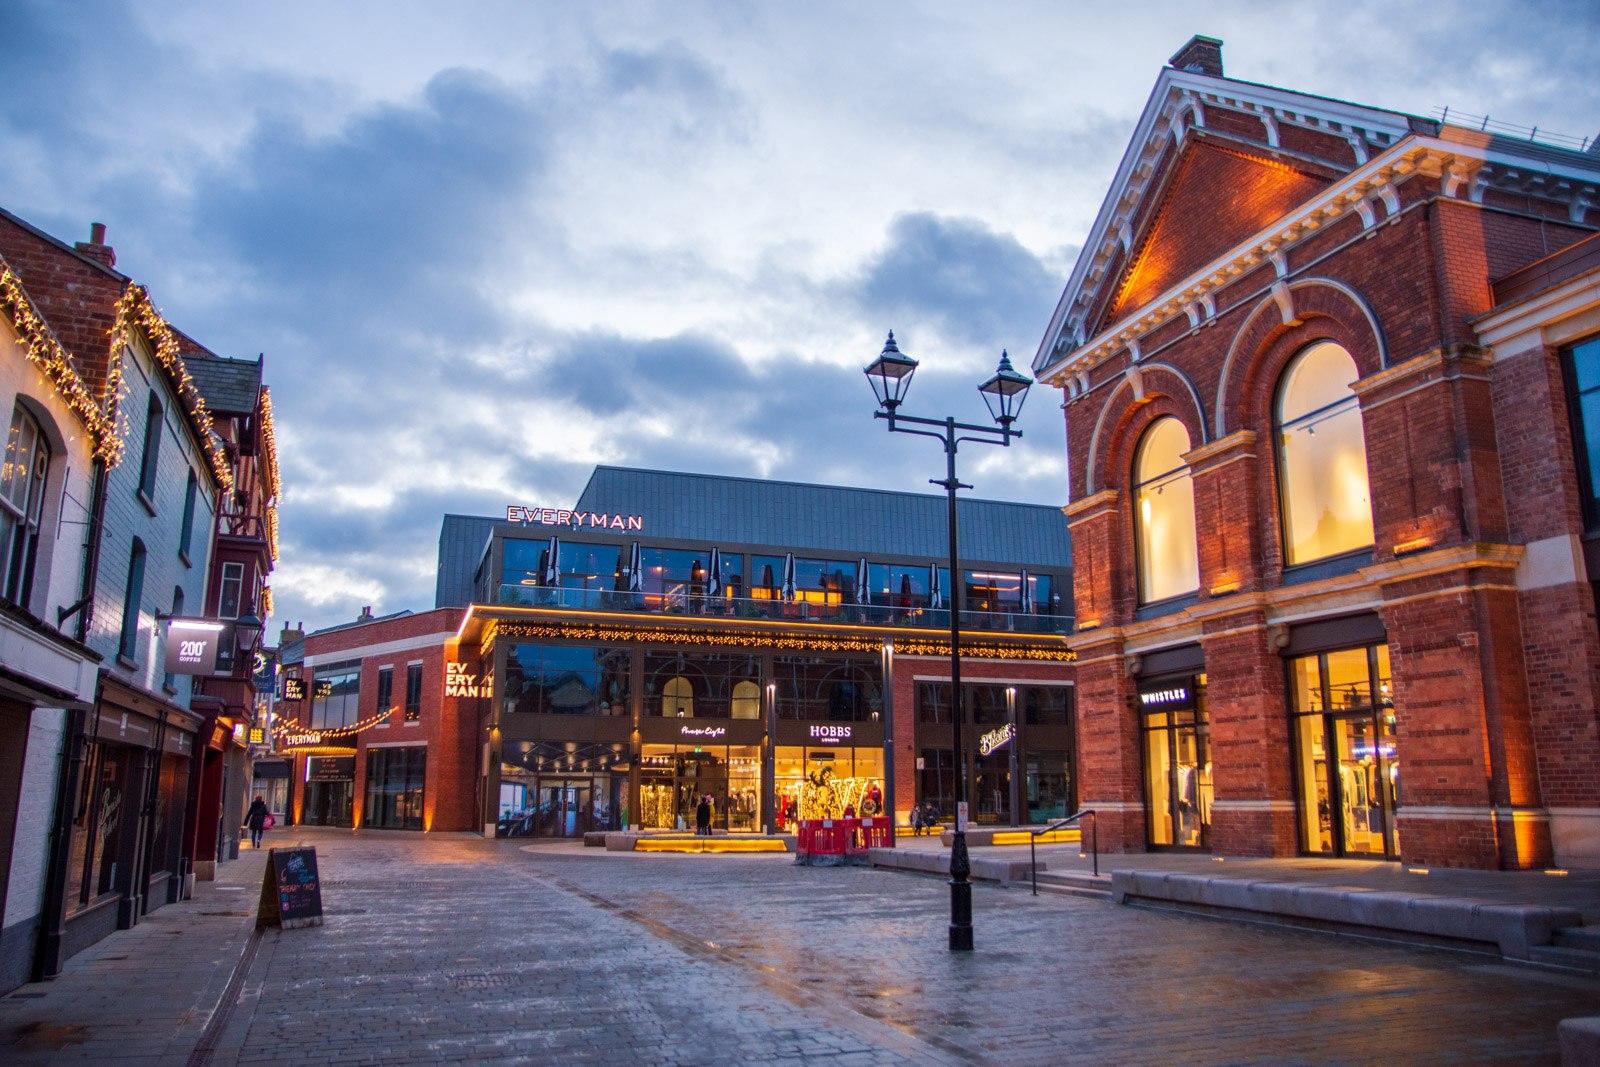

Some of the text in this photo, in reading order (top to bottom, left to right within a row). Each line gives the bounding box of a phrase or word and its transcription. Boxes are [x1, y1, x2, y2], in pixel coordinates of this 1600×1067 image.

[507, 505, 643, 531] EVERYMAN
[446, 663, 468, 673] EV
[446, 674, 476, 685] ERY
[445, 686, 478, 697] MAN
[1141, 688, 1186, 704] WHISTLES
[681, 726, 726, 738] Phase Eight
[810, 726, 851, 737] HOBBS
[287, 734, 322, 745] EVERYMAN
